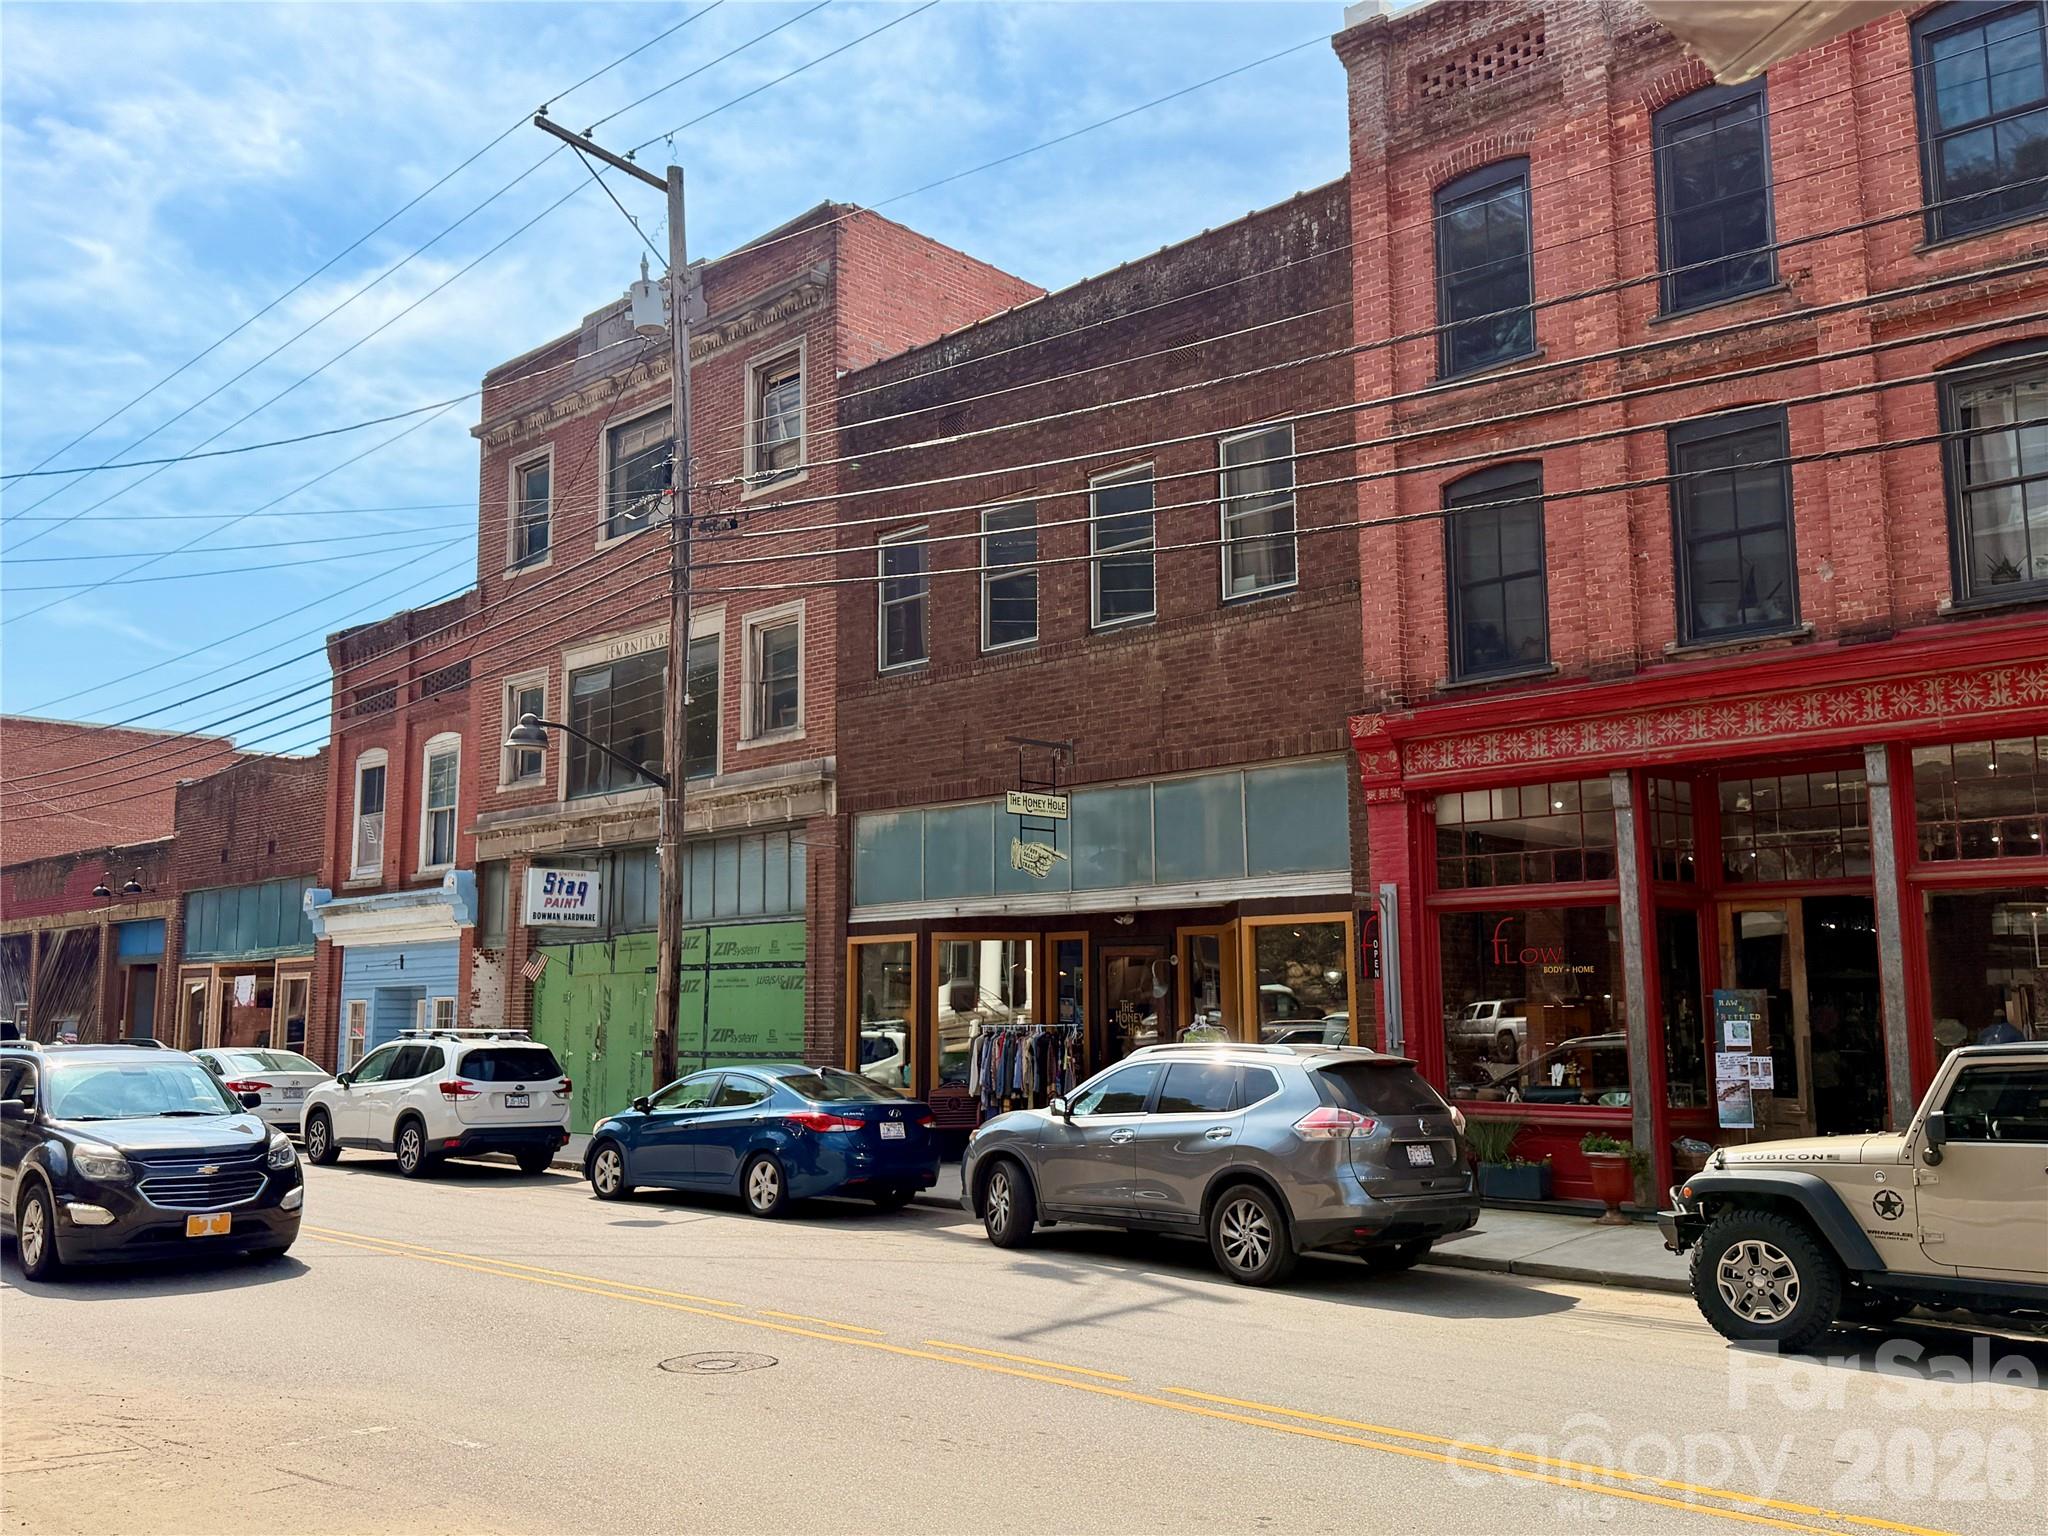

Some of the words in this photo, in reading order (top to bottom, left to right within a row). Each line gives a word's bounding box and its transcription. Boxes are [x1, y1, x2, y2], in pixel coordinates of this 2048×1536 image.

[1008, 792, 1021, 806] THE
[1022, 795, 1047, 813] HONEY
[1048, 798, 1066, 811] HOLE
[543, 872, 589, 906] Stag
[544, 897, 579, 908] PAINT
[532, 912, 561, 921] BOWMAN
[563, 912, 596, 922] HARDWARE
[1372, 939, 1380, 978] OPEN
[1543, 966, 1564, 974] BODY
[1572, 965, 1595, 973] HOME
[1120, 999, 1135, 1012] THE
[1115, 1010, 1144, 1029] HONEY
[1741, 1153, 1824, 1161] RUBICON
